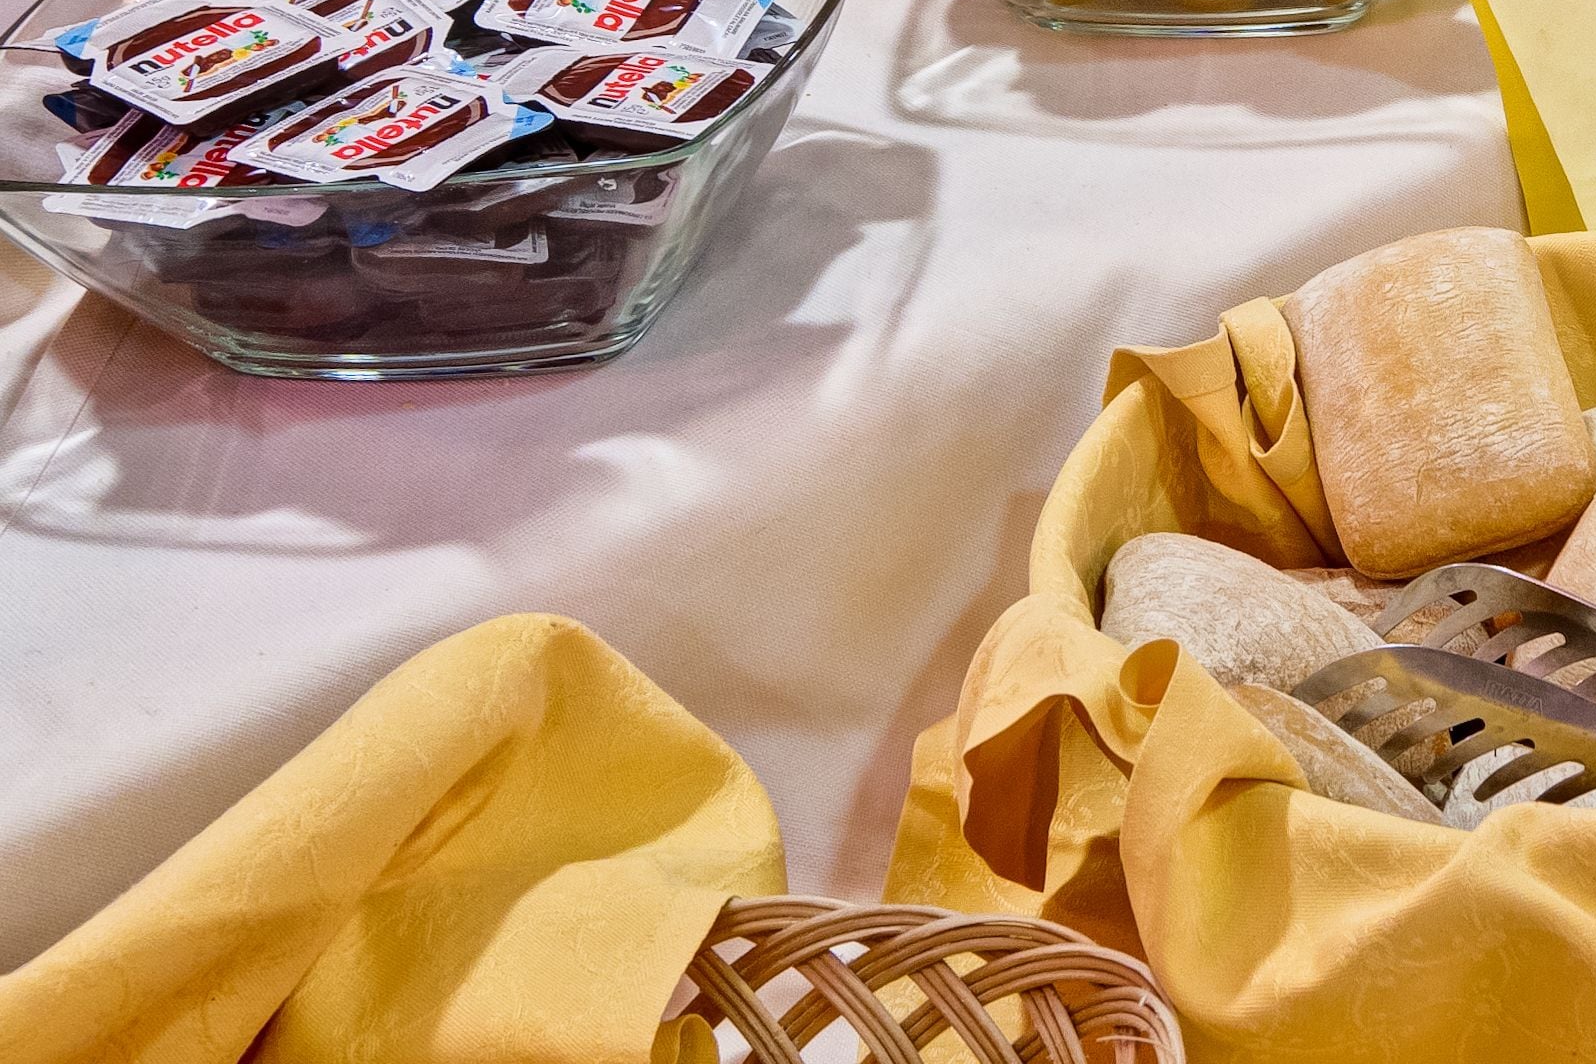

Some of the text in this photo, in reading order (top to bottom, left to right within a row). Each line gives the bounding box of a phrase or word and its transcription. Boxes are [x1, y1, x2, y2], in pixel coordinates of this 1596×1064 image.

[128, 11, 265, 77] nutella
[587, 54, 666, 109] nutella
[330, 94, 461, 160] nutella
